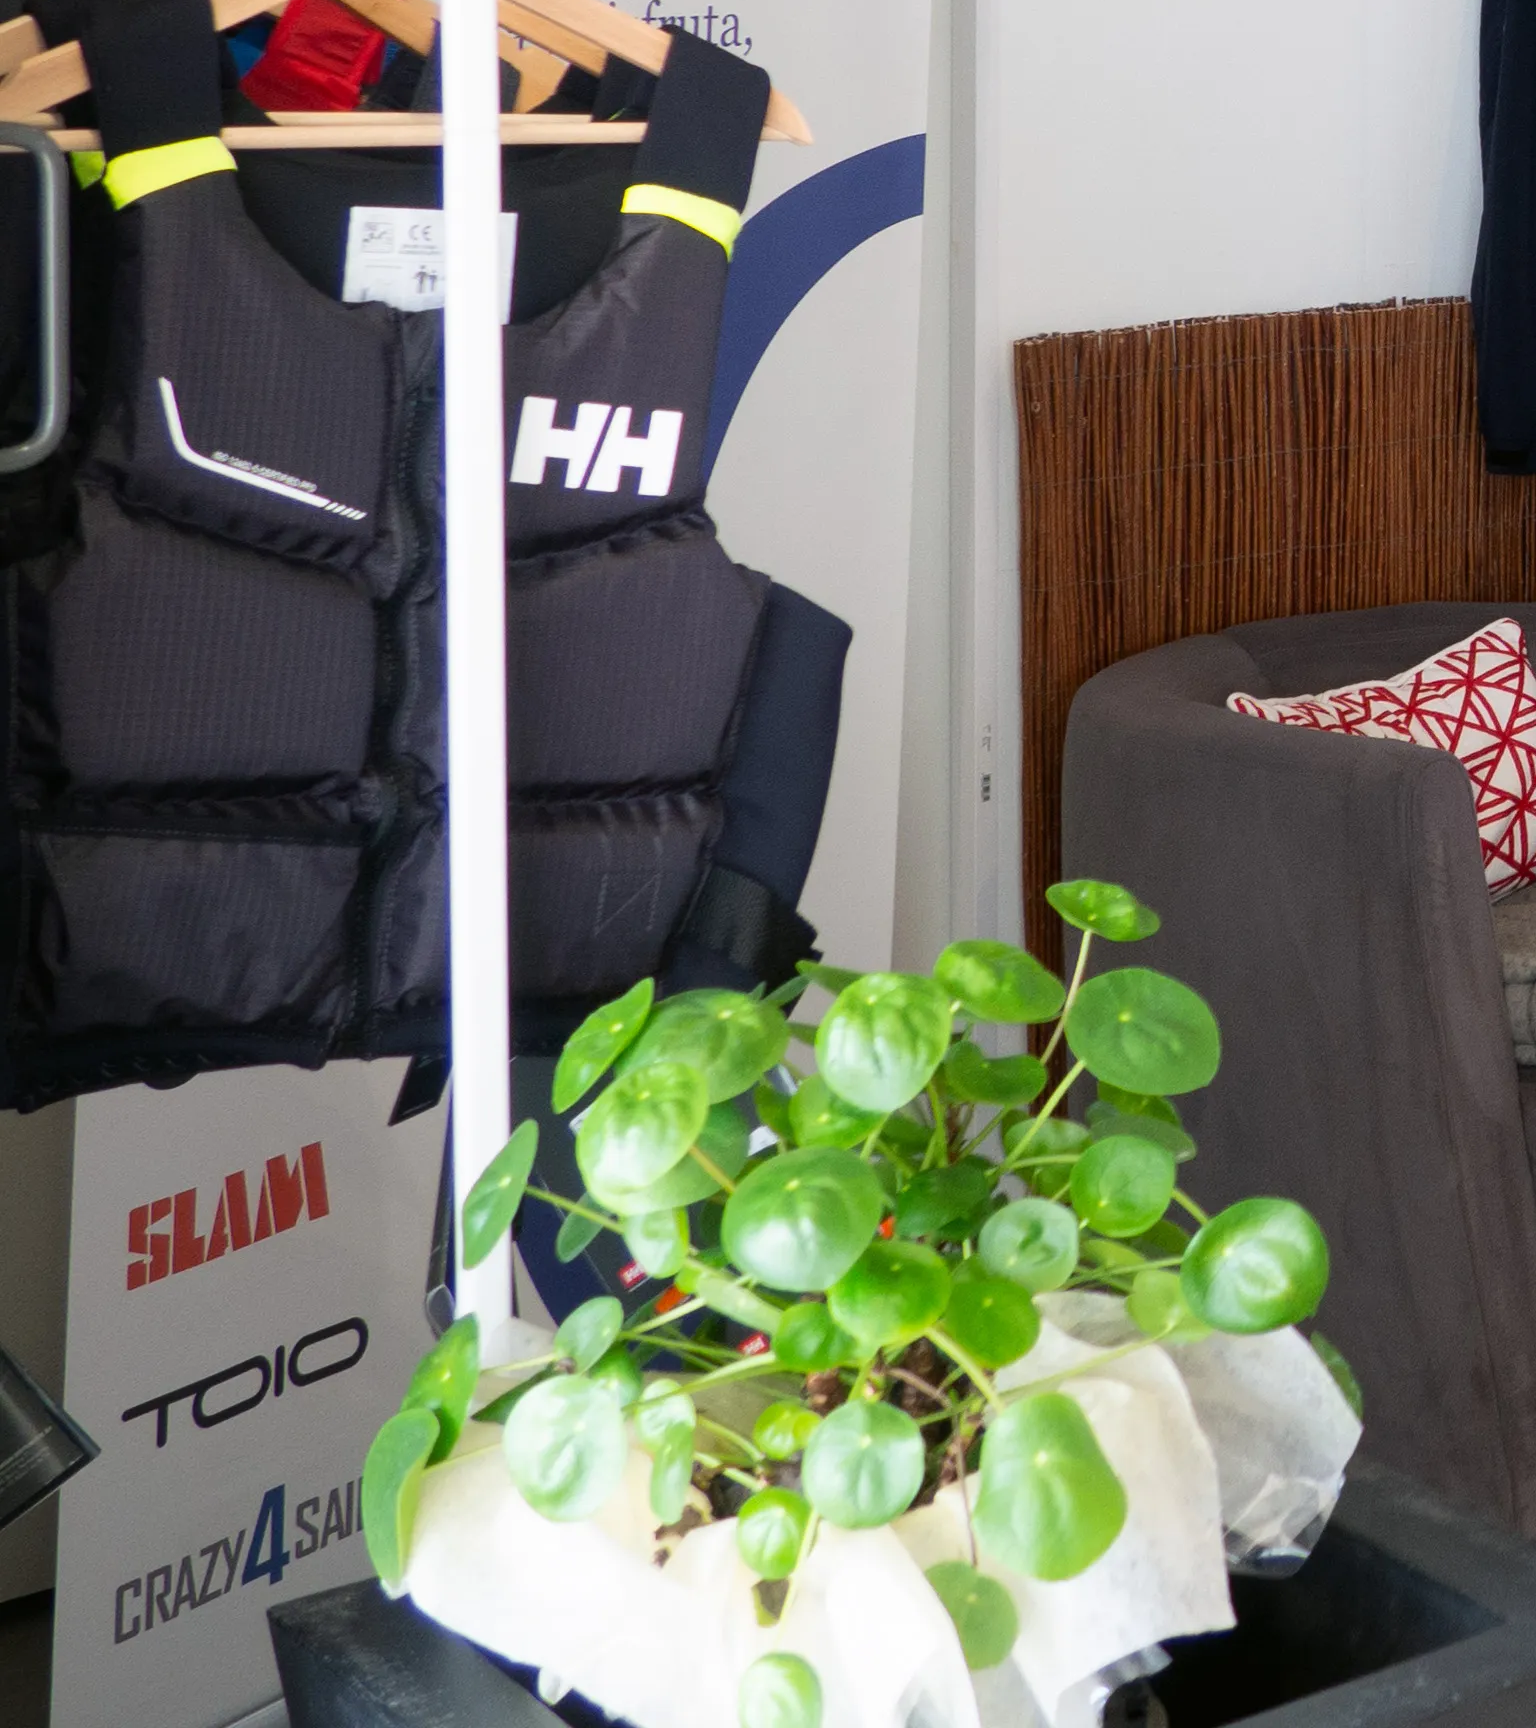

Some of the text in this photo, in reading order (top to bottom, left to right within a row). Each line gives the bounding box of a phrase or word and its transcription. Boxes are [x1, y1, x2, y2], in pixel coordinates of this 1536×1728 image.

[510, 395, 684, 497] HH
[127, 1141, 330, 1291] SLAM
[121, 1317, 369, 1449] TOIO
